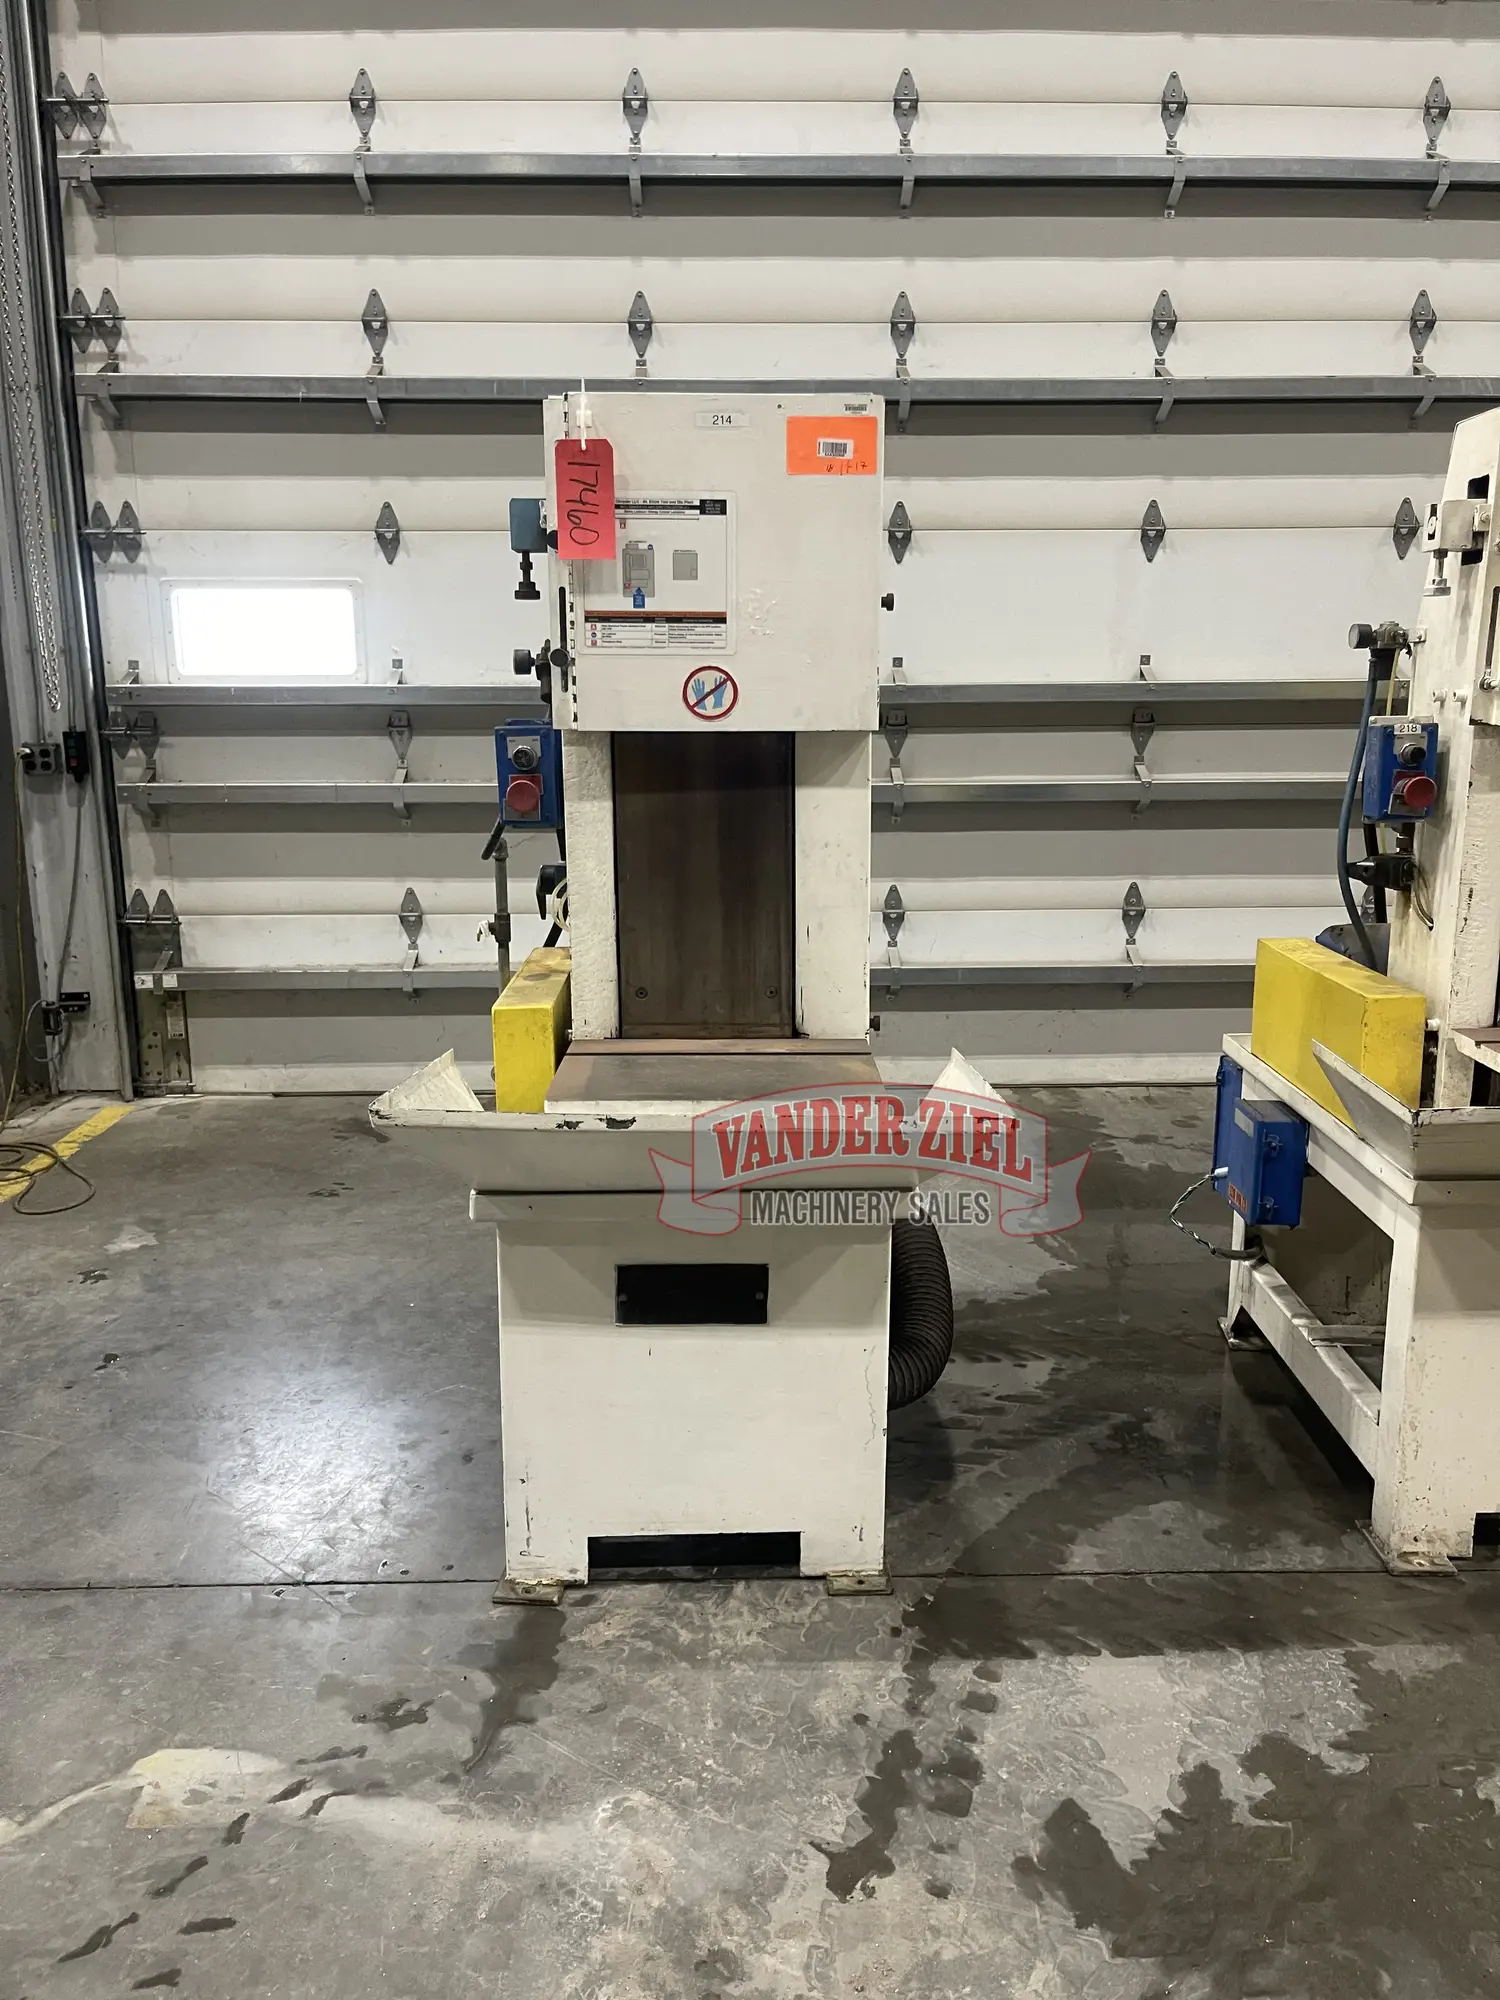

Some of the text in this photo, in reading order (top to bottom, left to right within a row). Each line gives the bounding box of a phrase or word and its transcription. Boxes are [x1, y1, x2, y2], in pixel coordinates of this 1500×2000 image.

[712, 414, 732, 426] 214
[565, 461, 601, 546] 17460
[1399, 724, 1418, 733] 218
